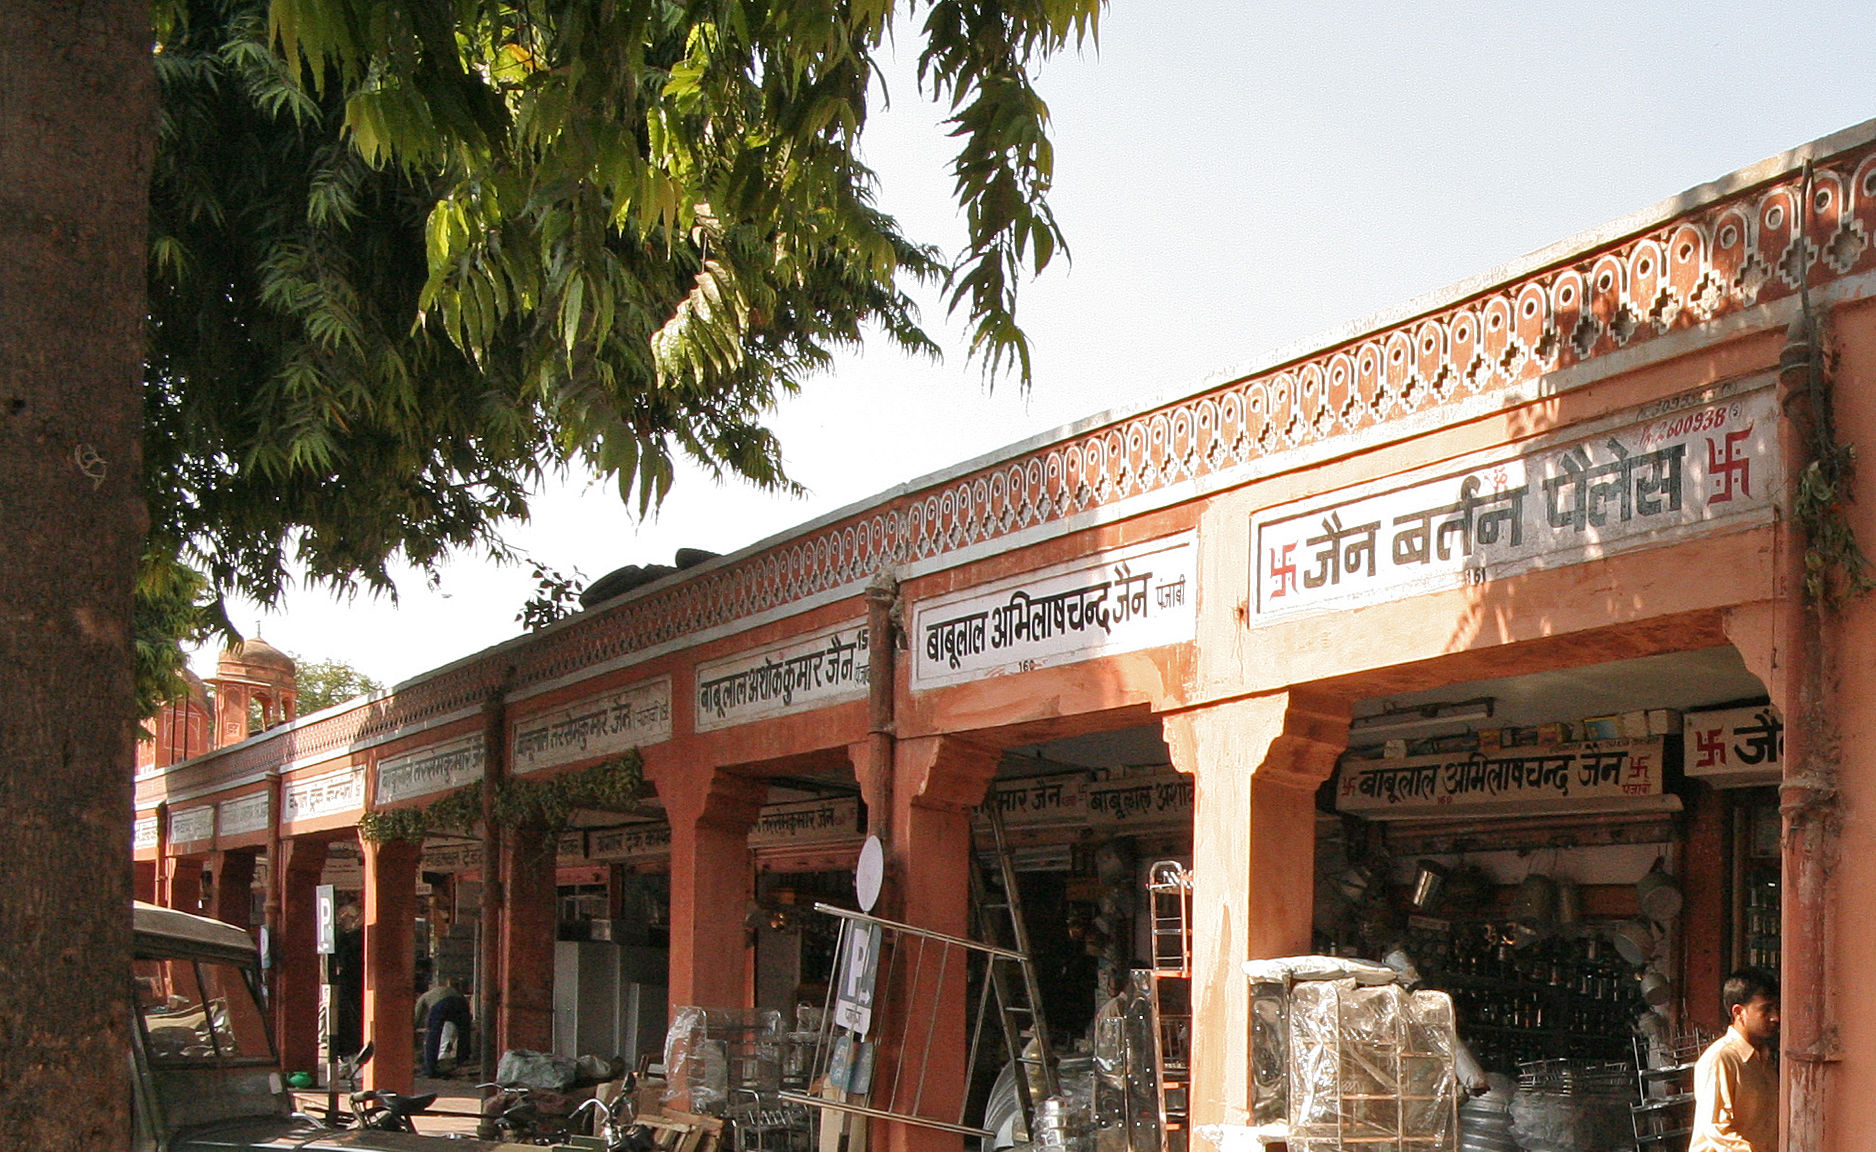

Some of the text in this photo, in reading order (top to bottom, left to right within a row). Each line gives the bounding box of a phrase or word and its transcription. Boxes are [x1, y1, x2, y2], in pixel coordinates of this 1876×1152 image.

[1303, 435, 1688, 589] जैन बर्तन पैलेस
[924, 608, 989, 670] बाबूलाल
[990, 589, 1113, 650] अभिलाषचन्द
[1112, 560, 1154, 625] जैन
[700, 670, 750, 719] बाबूलाल
[825, 633, 857, 686] जैन
[1358, 764, 1442, 804] बाबूलाल
[1577, 741, 1629, 787] जैन
[1732, 706, 1784, 766] जै
